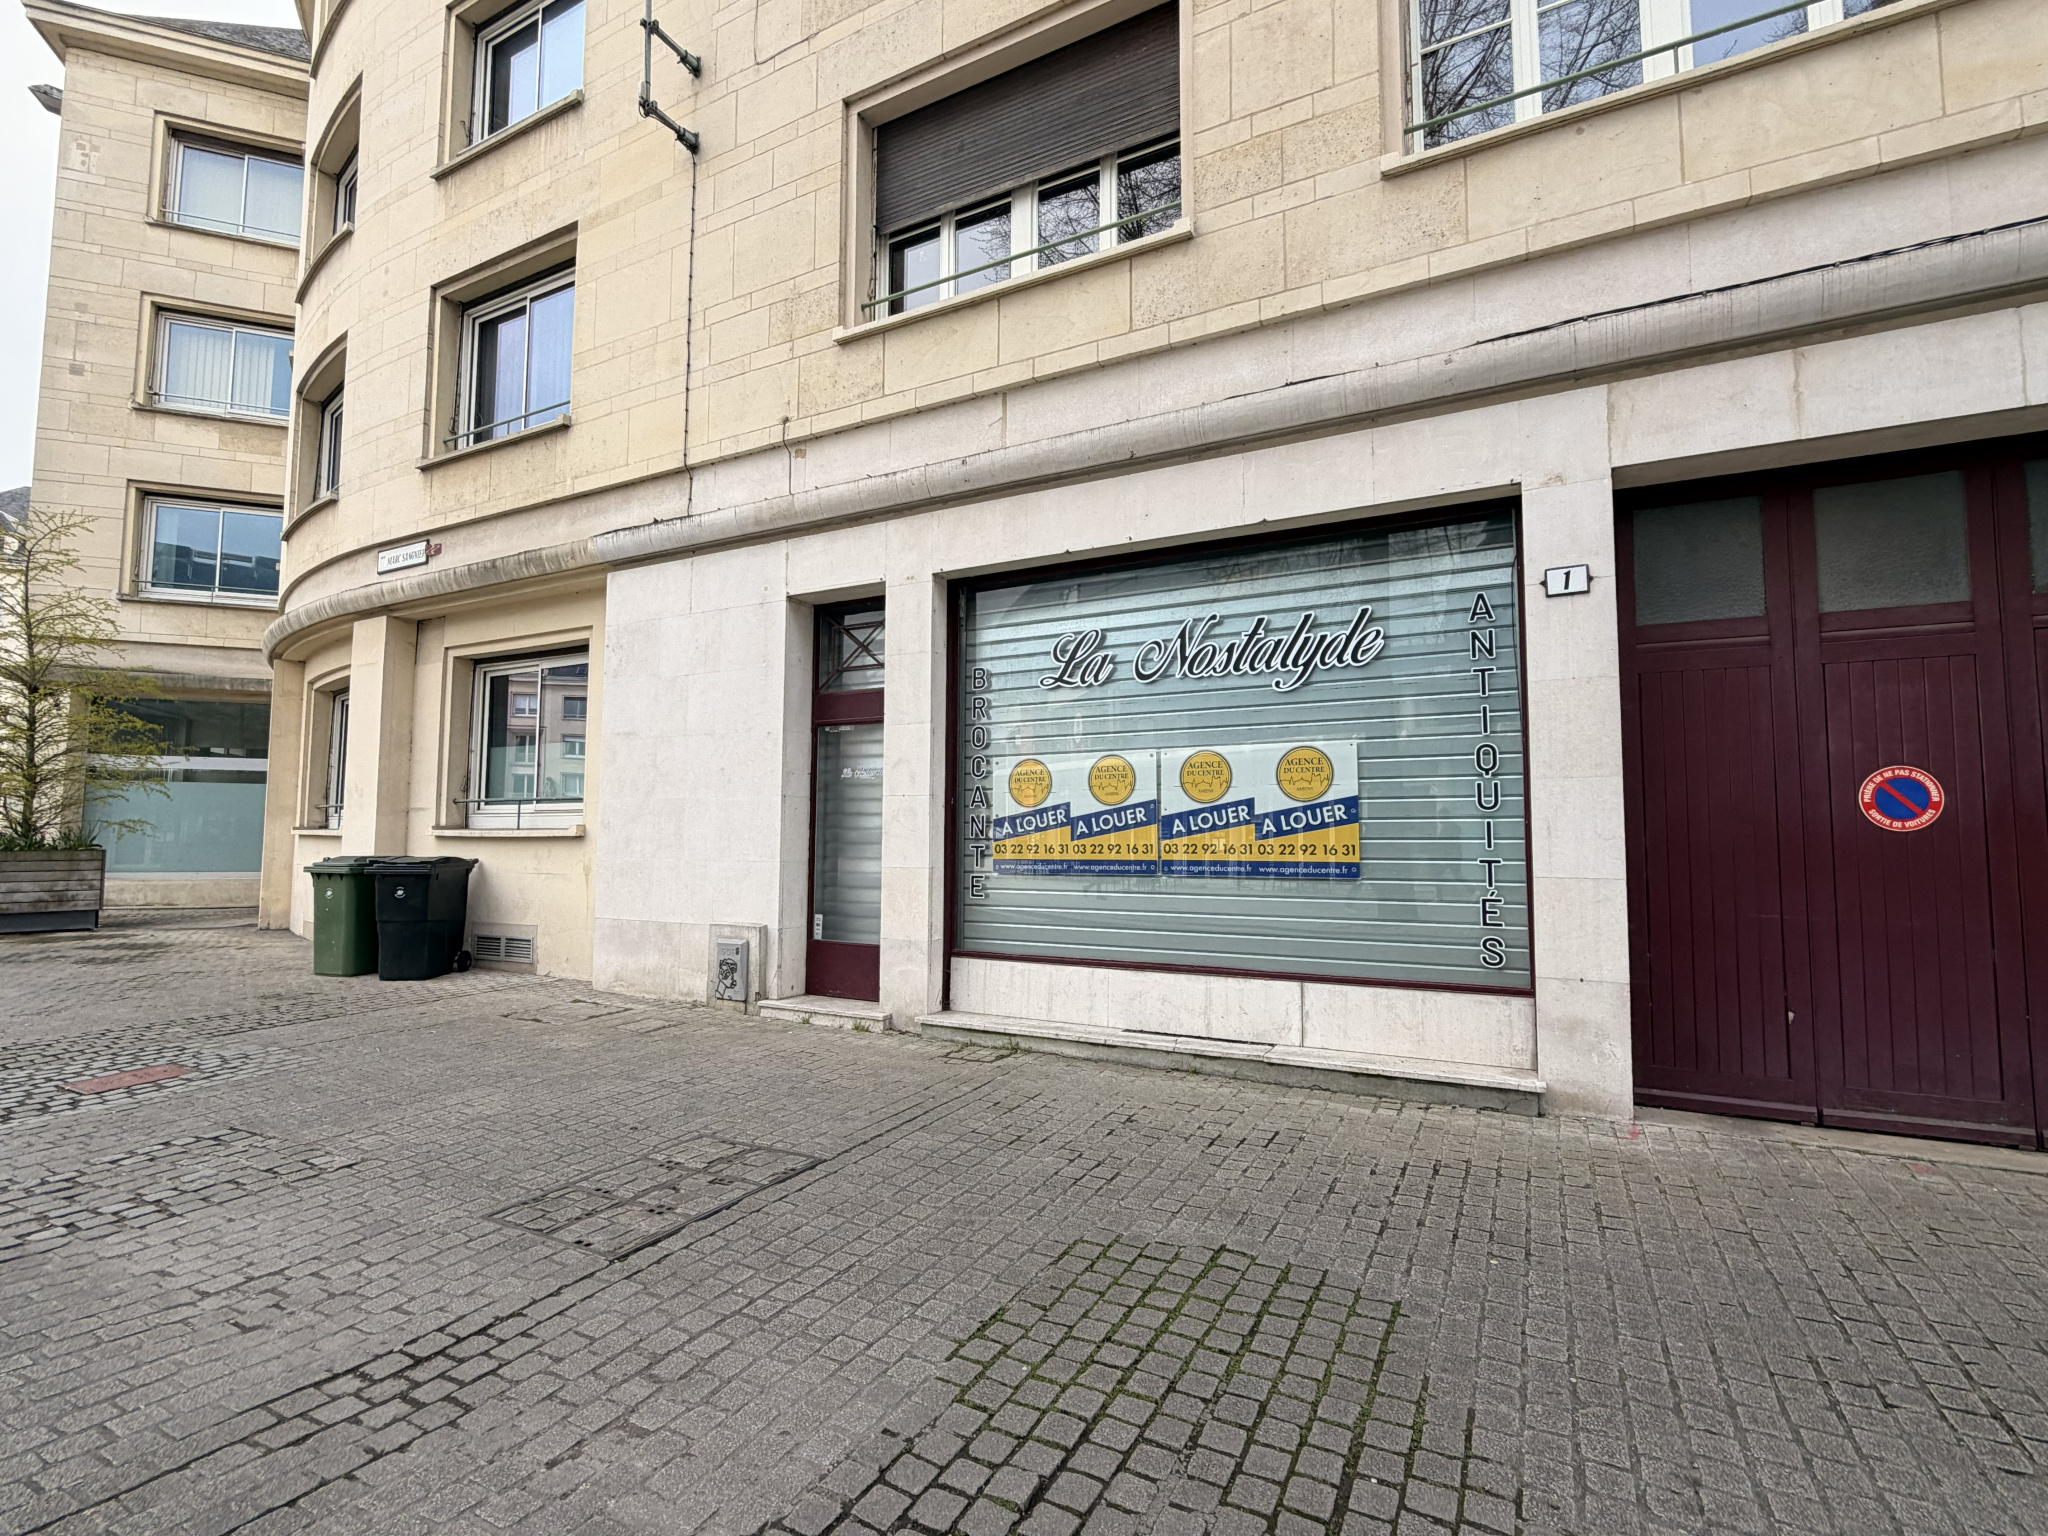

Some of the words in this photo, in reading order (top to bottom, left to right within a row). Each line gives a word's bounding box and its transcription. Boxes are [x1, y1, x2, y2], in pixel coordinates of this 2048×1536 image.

[1563, 569, 1571, 590] 1
[1038, 628, 1113, 690] La
[1133, 605, 1384, 692] Nostalyde
[1187, 761, 1223, 770] AGENCE
[1285, 758, 1324, 766] AGENCE
[1095, 765, 1128, 773] AGENCE
[970, 667, 987, 899] BROCANTE
[1469, 592, 1506, 968] ANTIQUITÉS
[1873, 775, 1884, 783] DE
[1910, 771, 1940, 801] STATIONNER
[1002, 825, 1013, 836] A
[1016, 809, 1067, 833] LOUER
[1076, 824, 1089, 836] A
[1091, 807, 1147, 832] LOUER
[1172, 819, 1186, 835] A
[1189, 805, 1251, 831] LOUER
[1262, 818, 1277, 835] A
[1281, 804, 1348, 832] LOUER
[1869, 809, 1891, 826] SORTIE
[1904, 809, 1936, 827] VOITURES
[995, 844, 1007, 854] 03
[1011, 844, 1023, 854] 22
[1026, 844, 1039, 854] 92
[1044, 844, 1055, 854] 16
[1057, 844, 1069, 854] 31
[1073, 844, 1087, 854] 03
[1090, 844, 1104, 854] 22
[1108, 844, 1122, 854] 92
[1126, 844, 1139, 854] 16
[1142, 844, 1154, 854] 31
[1163, 843, 1179, 855] 03
[1182, 843, 1198, 855] 22
[1201, 844, 1217, 855] 92
[1222, 844, 1236, 855] 16
[1240, 844, 1253, 855] 31
[1258, 844, 1274, 856] 03
[1279, 844, 1296, 856] 22
[1300, 844, 1317, 856] 92
[1323, 844, 1338, 856] 16
[1342, 845, 1356, 856] 31
[1001, 863, 1068, 871] www.agenceducentre.fr
[1073, 863, 1147, 872] www.agenceducentre.fr
[1170, 864, 1252, 872] www.agenceducentre.fr
[1259, 864, 1348, 874] www.agenceducentre.fr
